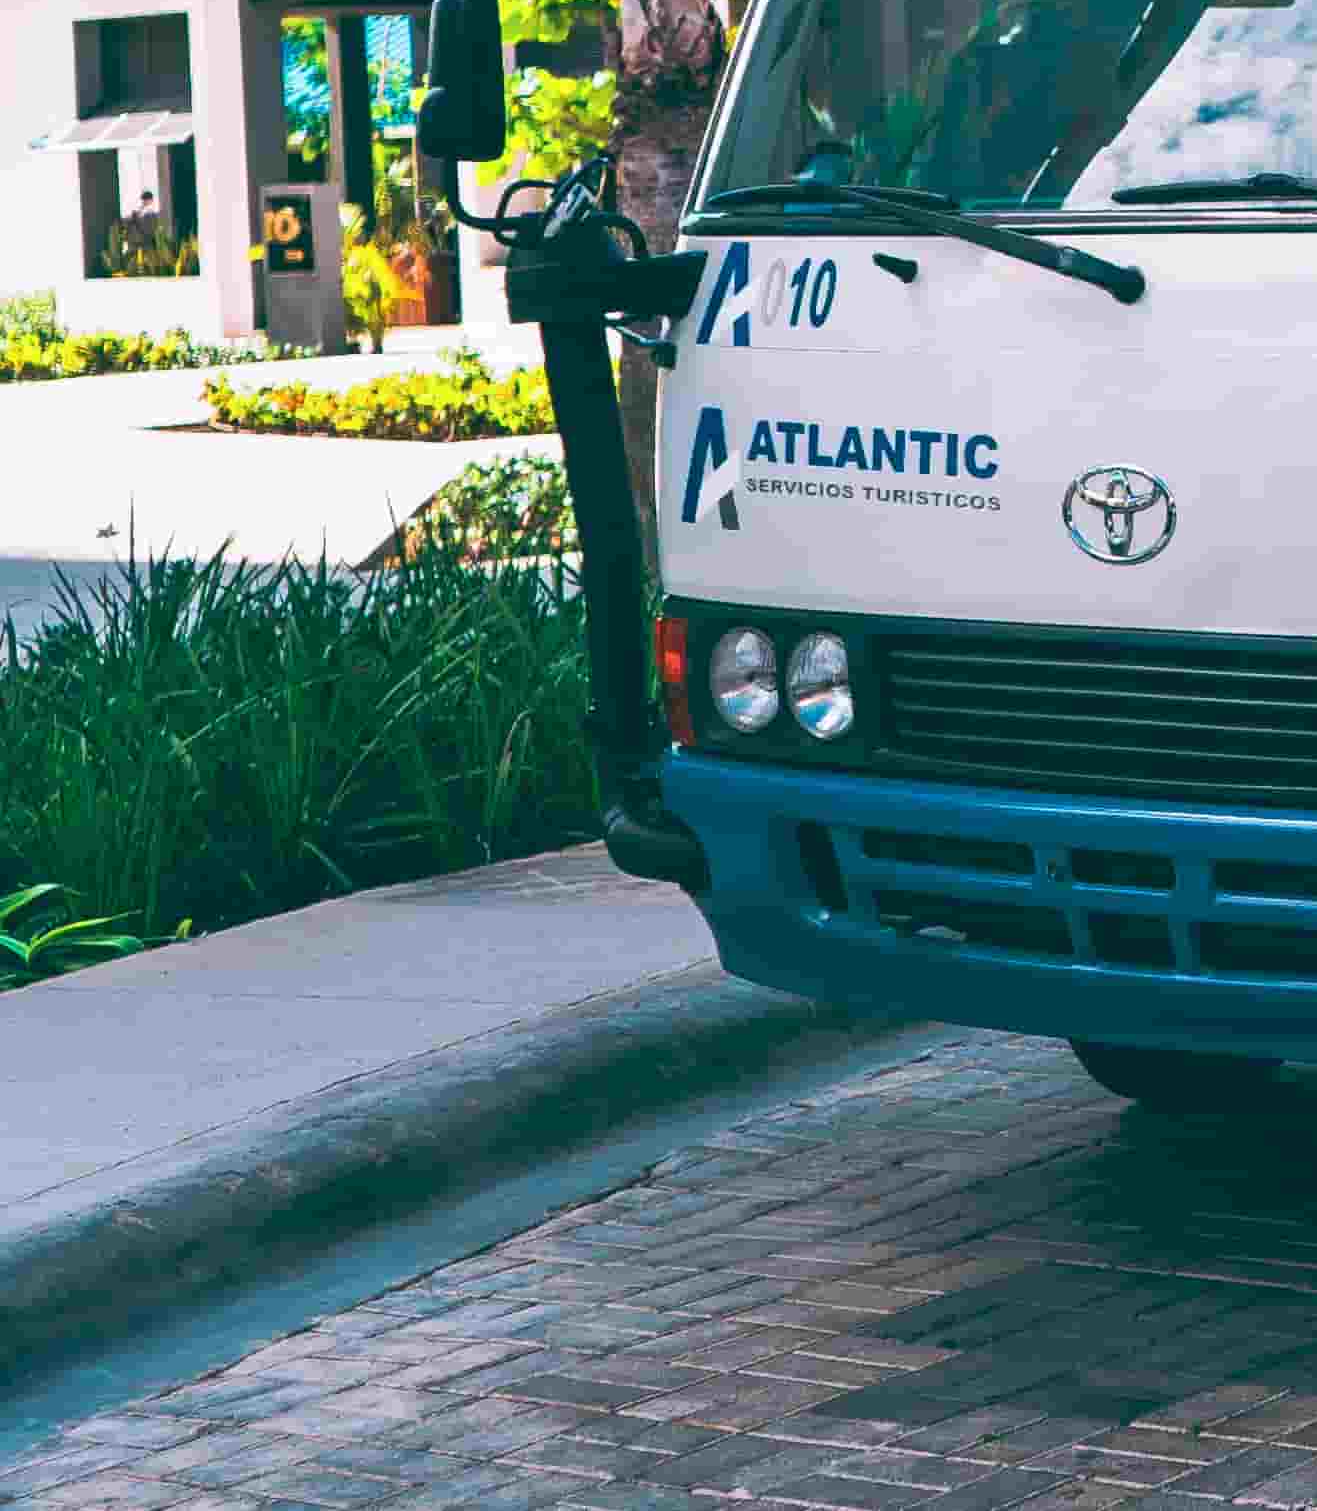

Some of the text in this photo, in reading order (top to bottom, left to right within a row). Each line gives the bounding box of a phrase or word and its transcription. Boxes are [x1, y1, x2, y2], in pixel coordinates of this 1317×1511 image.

[746, 420, 999, 479] ATLANTIC
[745, 477, 1001, 511] SERVICIOS TURISTICOS
